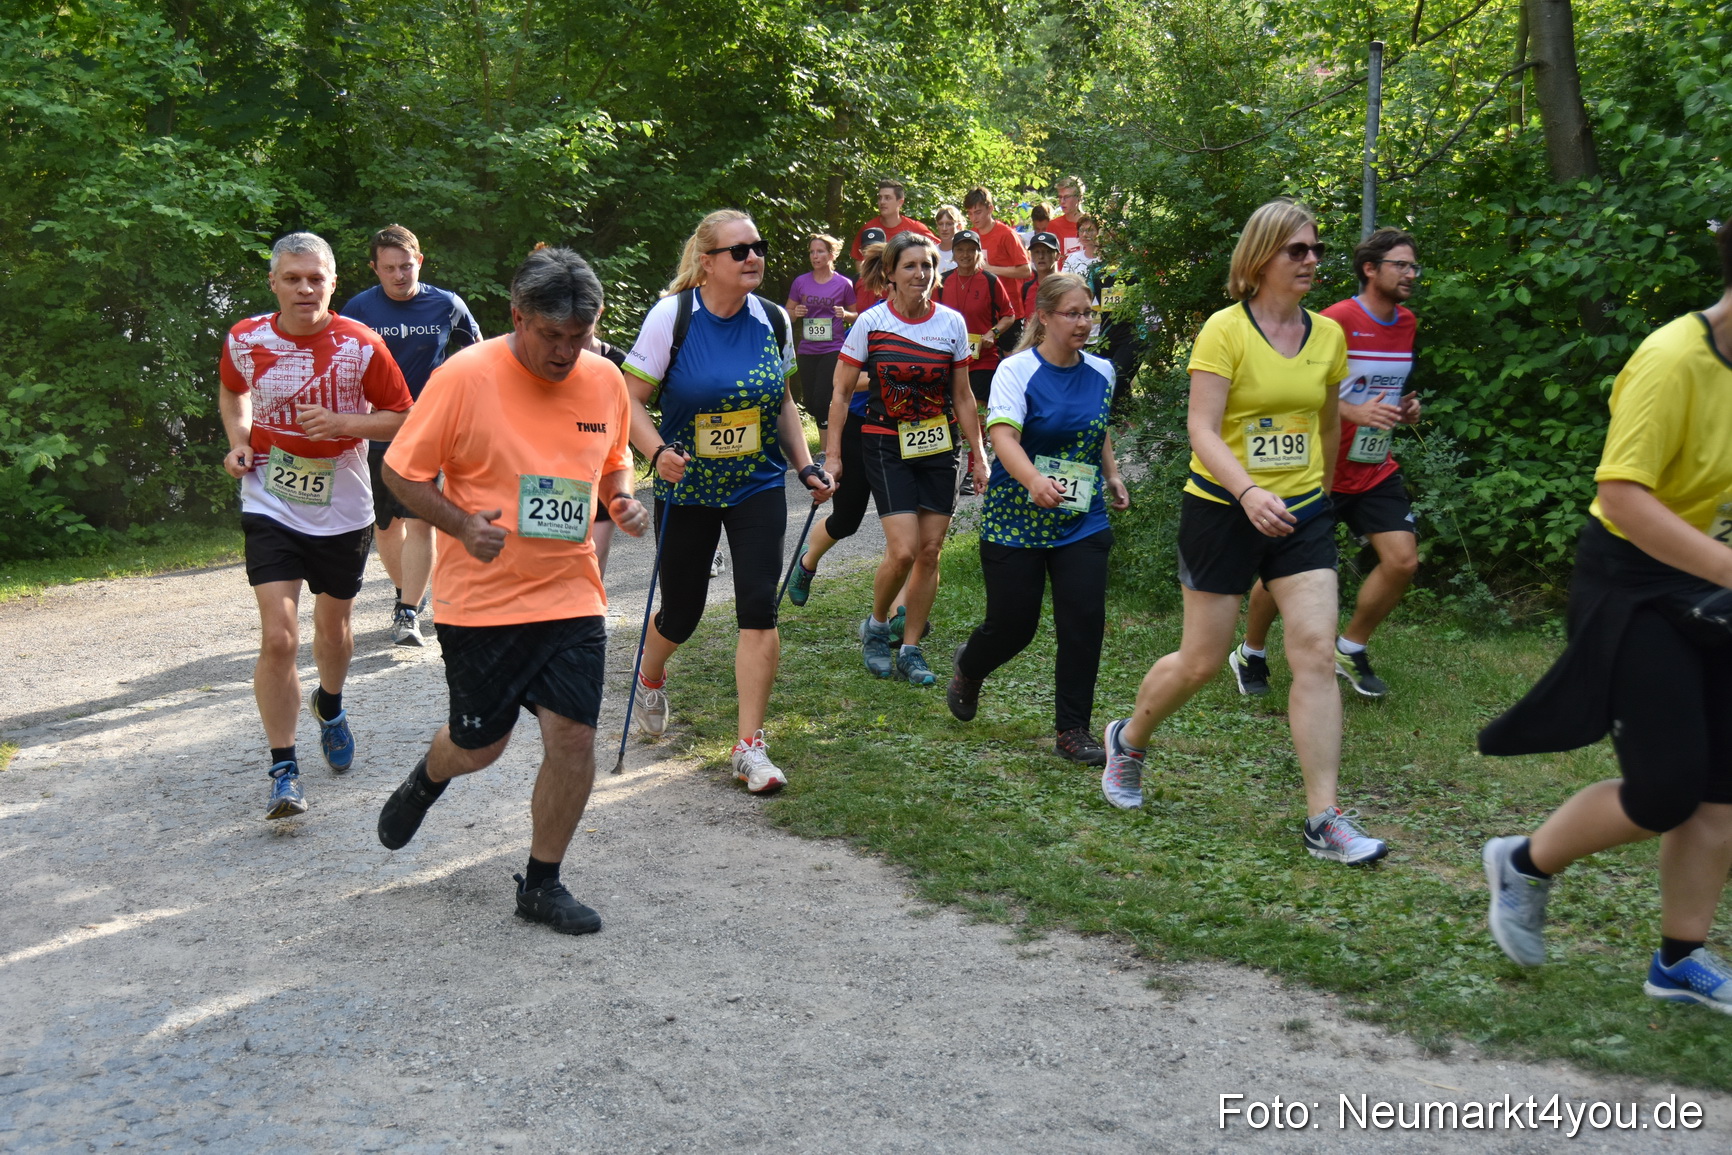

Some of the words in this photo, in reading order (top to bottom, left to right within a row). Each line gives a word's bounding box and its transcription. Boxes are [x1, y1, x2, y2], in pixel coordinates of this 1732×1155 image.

[409, 324, 441, 336] POLES
[808, 326, 826, 335] 939
[576, 422, 607, 433] THULE
[710, 426, 747, 446] 207
[906, 426, 944, 447] 2253
[1252, 434, 1305, 456] 2198
[273, 466, 325, 493] 2215
[528, 497, 584, 525] 2304
[1712, 519, 1732, 543] 2
